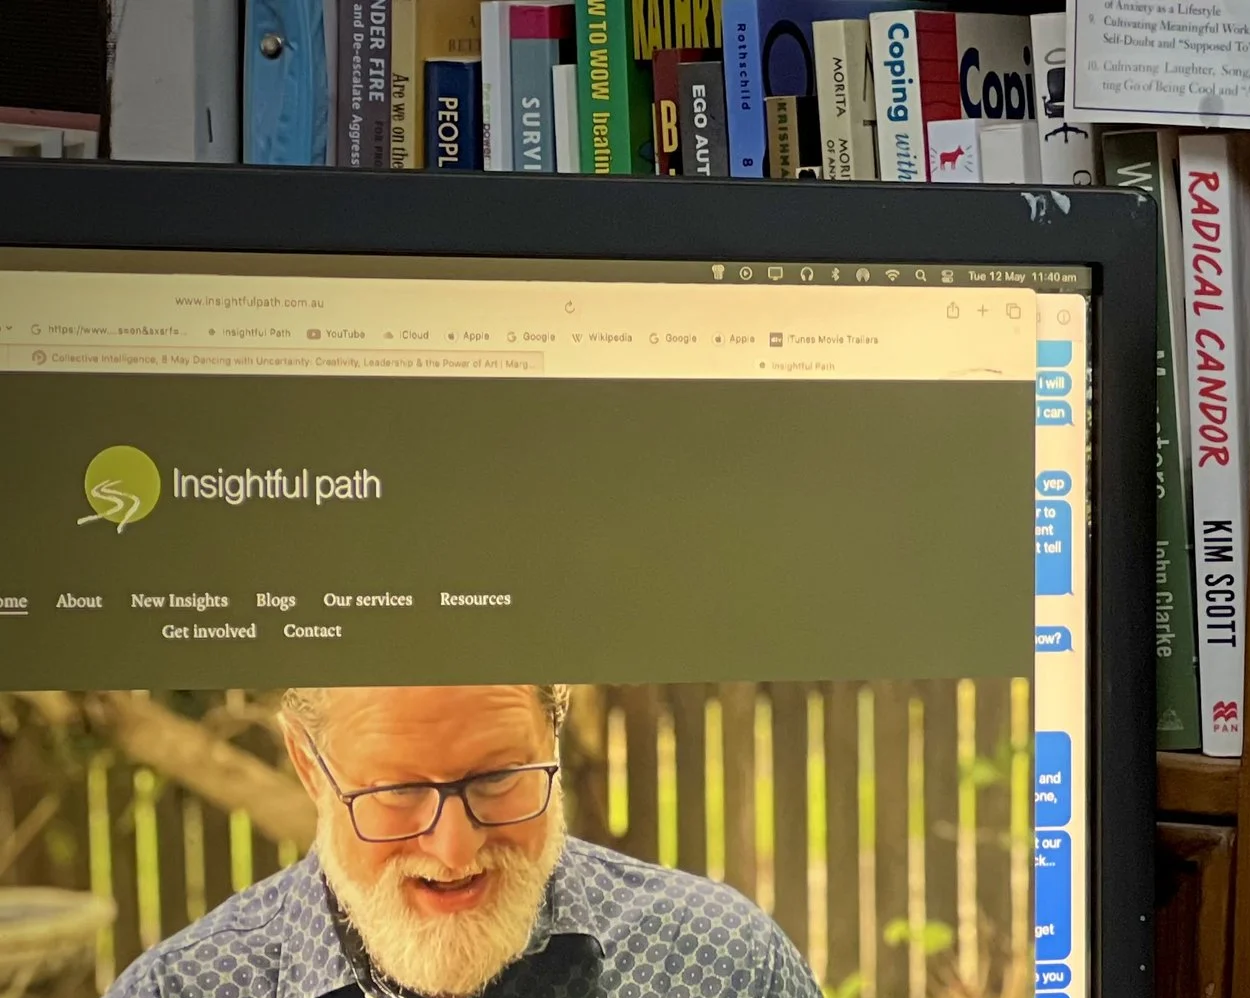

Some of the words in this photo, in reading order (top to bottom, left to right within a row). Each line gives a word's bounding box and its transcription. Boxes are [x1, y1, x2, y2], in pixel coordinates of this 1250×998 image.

[737, 23, 751, 110] Rothschild
[885, 23, 912, 122] Coping
[392, 73, 409, 98] Are
[832, 57, 846, 117] MORITA
[392, 103, 405, 121] we
[692, 84, 708, 128] EGO
[348, 114, 362, 167] Aggress
[392, 126, 405, 143] on
[438, 97, 458, 167] PEOPL
[522, 97, 542, 170] SURVI
[390, 147, 408, 173] the
[695, 134, 711, 176] AUT
[742, 158, 754, 167] 8
[895, 134, 916, 182] with
[1188, 172, 1223, 316] RADICAL
[968, 270, 986, 281] Tue
[989, 271, 1002, 281] 12
[1005, 271, 1026, 283] May
[1032, 272, 1060, 282] 11:40
[1061, 274, 1077, 282] am
[175, 296, 324, 309] www.insightfulpath.com.au
[326, 329, 366, 339] YouTube
[400, 330, 429, 340] iCloud
[463, 331, 490, 342] Apple
[523, 331, 556, 343] Google
[1039, 378, 1042, 389] I
[1045, 378, 1065, 389] will
[1195, 328, 1230, 467] CANDOR
[1043, 407, 1065, 418] can
[174, 467, 308, 505] Insightful
[316, 468, 381, 505] path
[1043, 479, 1064, 492] yep
[1203, 520, 1234, 562] KIM
[56, 593, 102, 608] About
[131, 594, 165, 608] New
[169, 592, 228, 611] Insights
[256, 592, 296, 611] Blogs
[323, 593, 353, 606] Our
[356, 592, 413, 606] services
[440, 592, 511, 606] Resources
[1204, 574, 1236, 648] SCOTT
[162, 624, 189, 639] Get
[193, 623, 256, 638] involved
[283, 624, 342, 638] Contact
[1214, 722, 1238, 732] PAN
